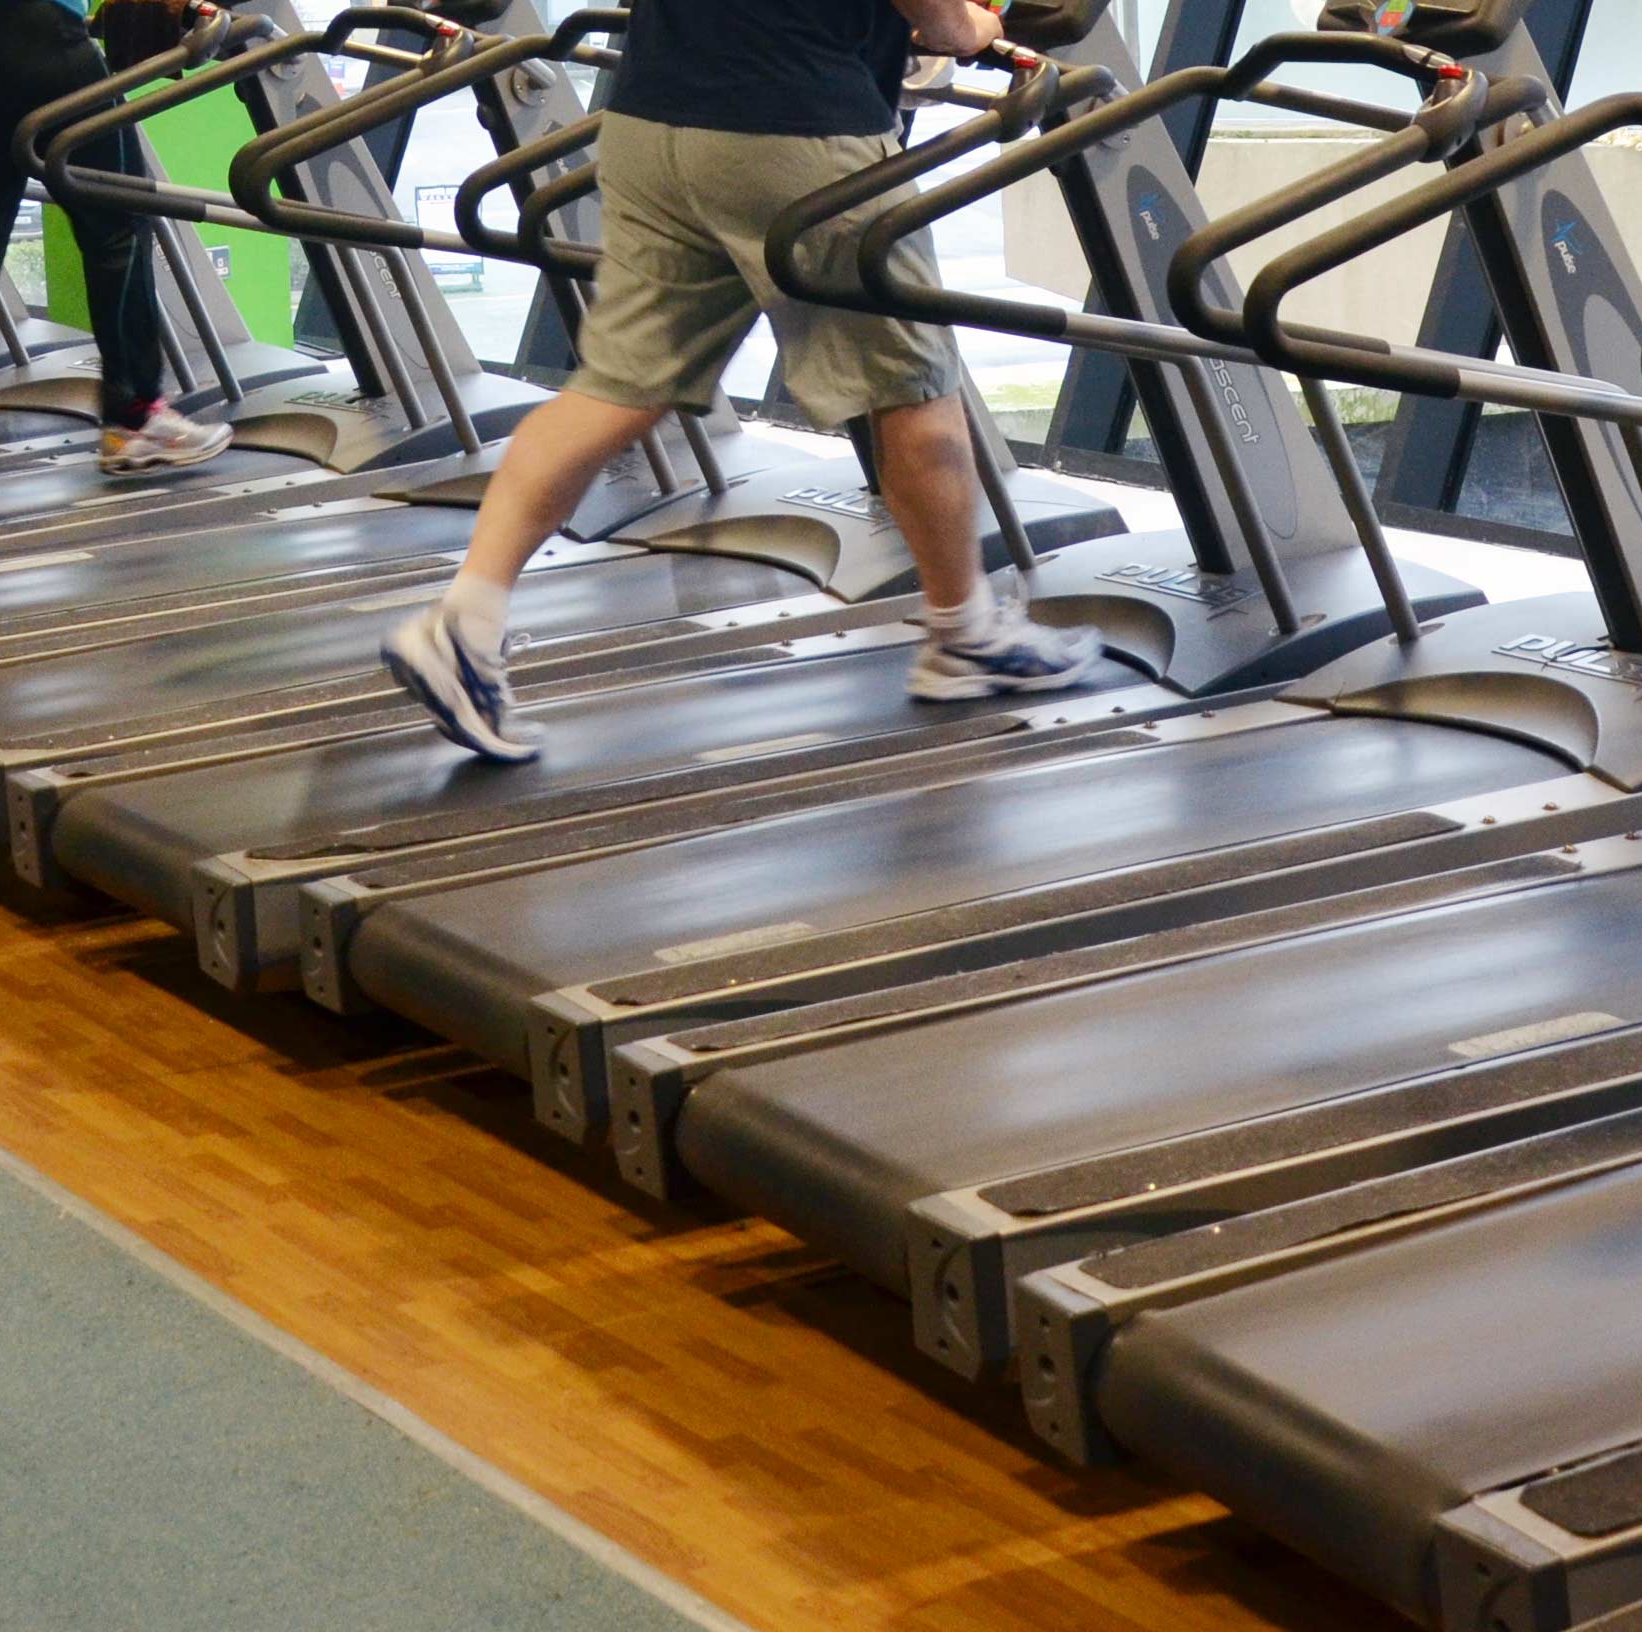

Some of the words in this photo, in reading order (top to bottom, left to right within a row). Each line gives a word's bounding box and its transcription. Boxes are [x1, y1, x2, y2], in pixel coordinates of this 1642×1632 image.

[1139, 210, 1160, 241] pulse
[1554, 240, 1577, 274] pulse
[369, 250, 402, 299] cent
